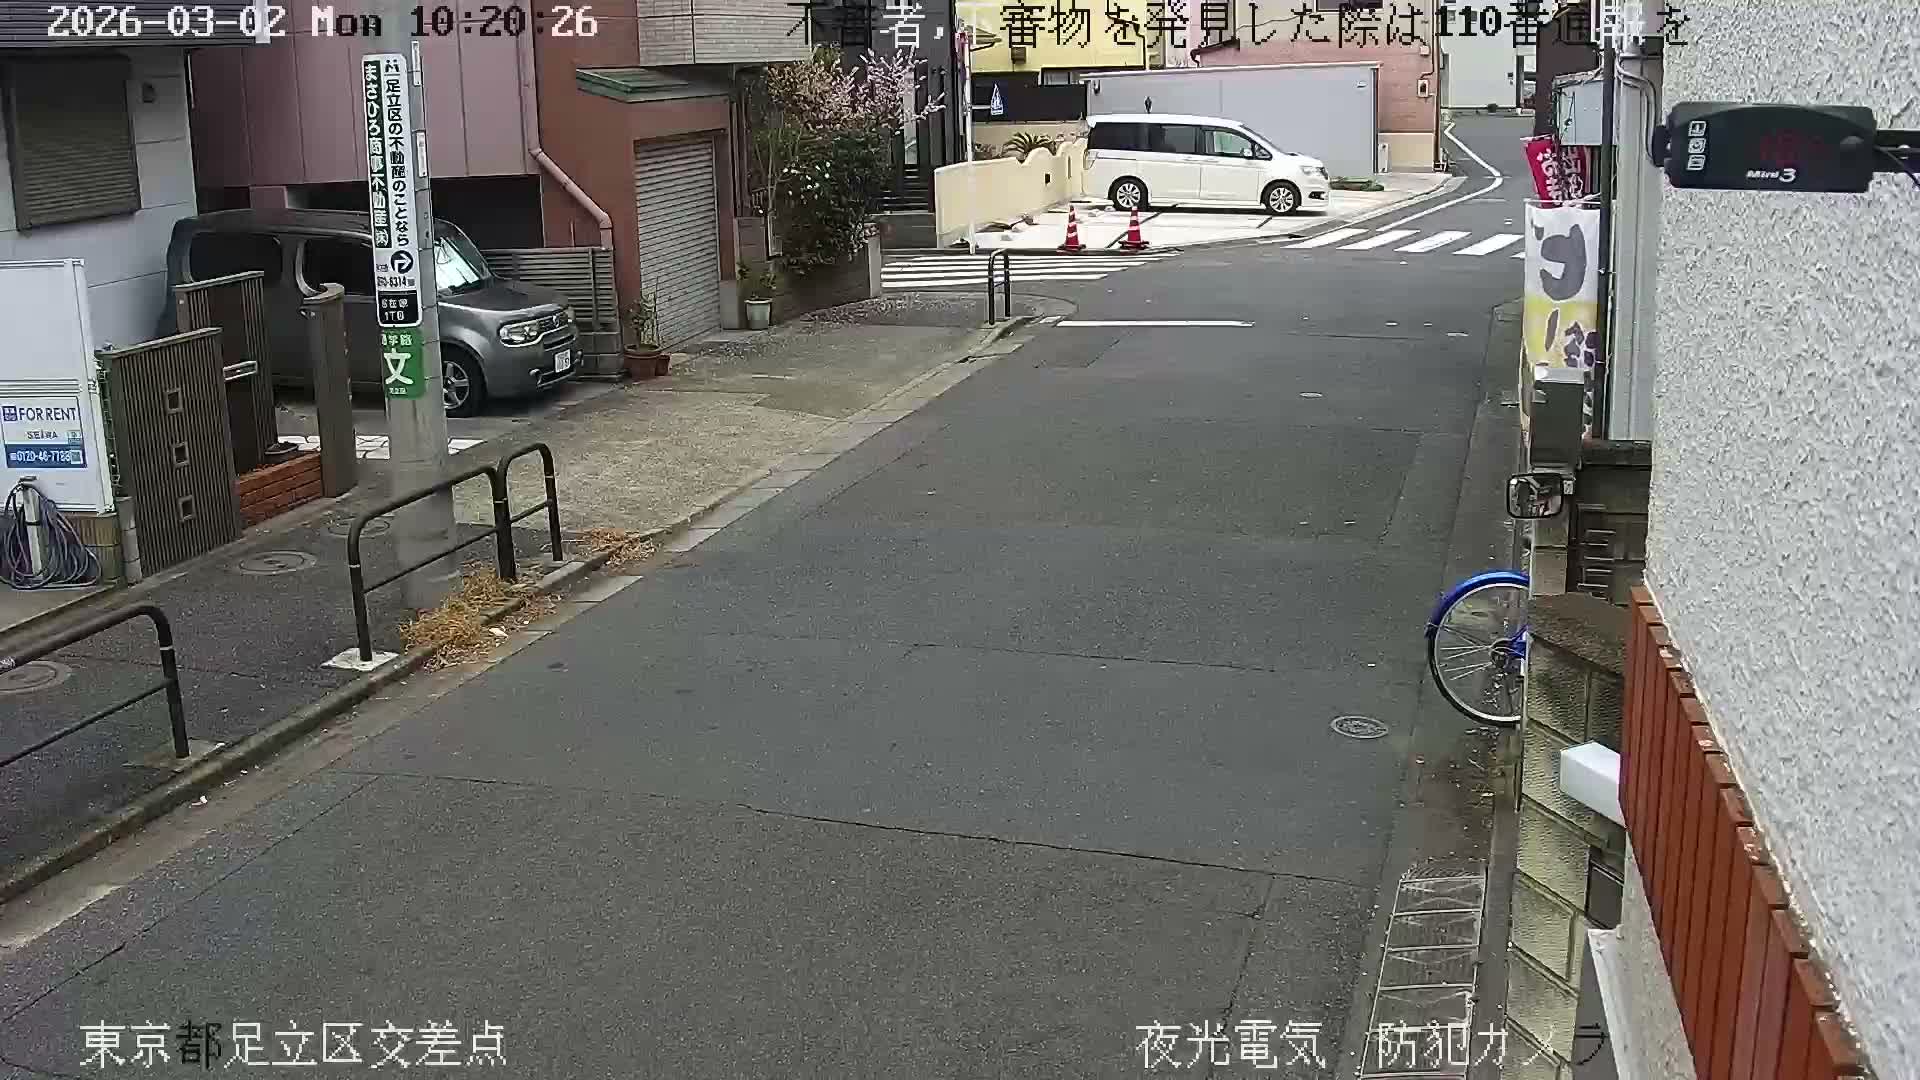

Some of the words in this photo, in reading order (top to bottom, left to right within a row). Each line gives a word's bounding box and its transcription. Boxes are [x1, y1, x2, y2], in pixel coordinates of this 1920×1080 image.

[386, 79, 409, 247] 足立区の不動産のことなら
[383, 347, 415, 385] 文
[18, 407, 44, 422] FOR
[45, 407, 77, 422] RENT
